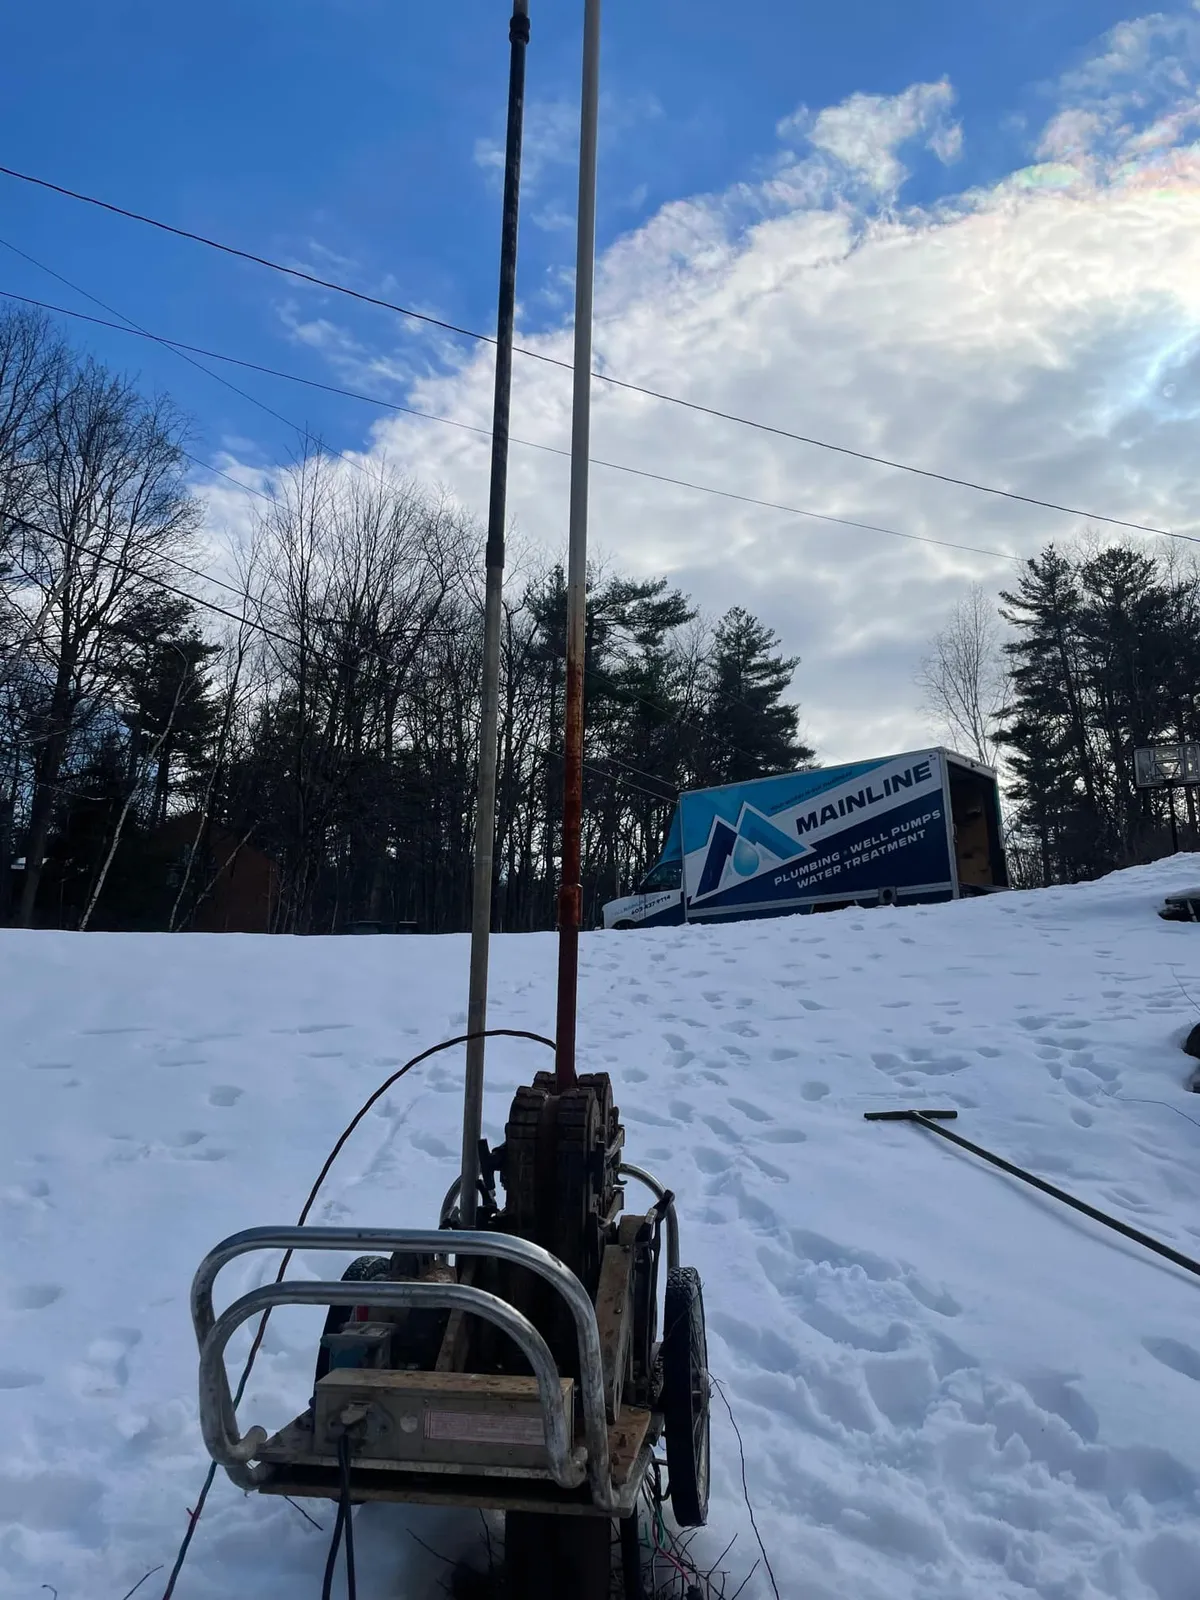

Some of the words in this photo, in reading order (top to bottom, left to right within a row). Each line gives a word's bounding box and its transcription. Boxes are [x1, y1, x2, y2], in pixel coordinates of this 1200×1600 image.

[795, 760, 932, 835] MAINLINE
[774, 851, 840, 886] PLUMBING
[849, 834, 889, 854] WELL
[891, 809, 941, 837] PUMPS
[796, 865, 842, 889] WATER
[843, 829, 926, 870] TREATMENT
